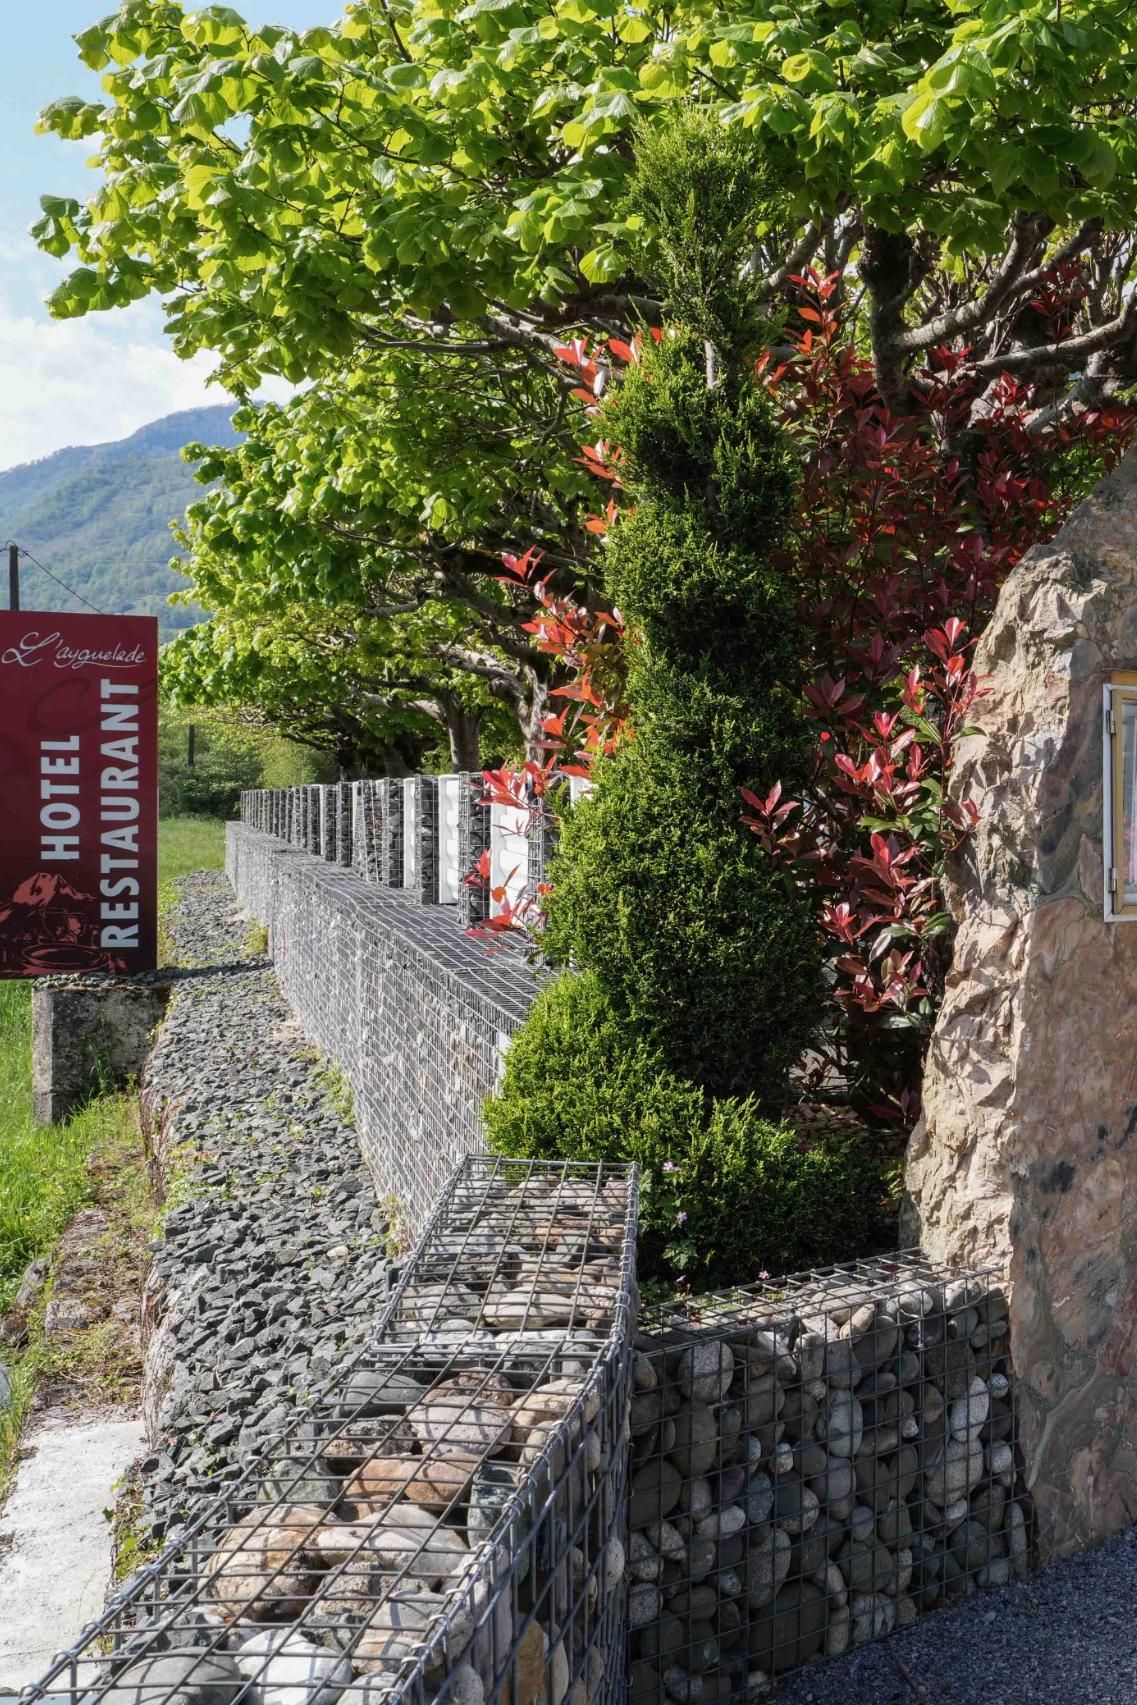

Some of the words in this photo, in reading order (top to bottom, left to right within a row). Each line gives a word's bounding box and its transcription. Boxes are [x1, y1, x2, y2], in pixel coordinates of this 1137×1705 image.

[1, 631, 145, 669] L'ayguelade
[40, 735, 80, 860] HOTEL
[100, 678, 140, 948] RESTAURANT
